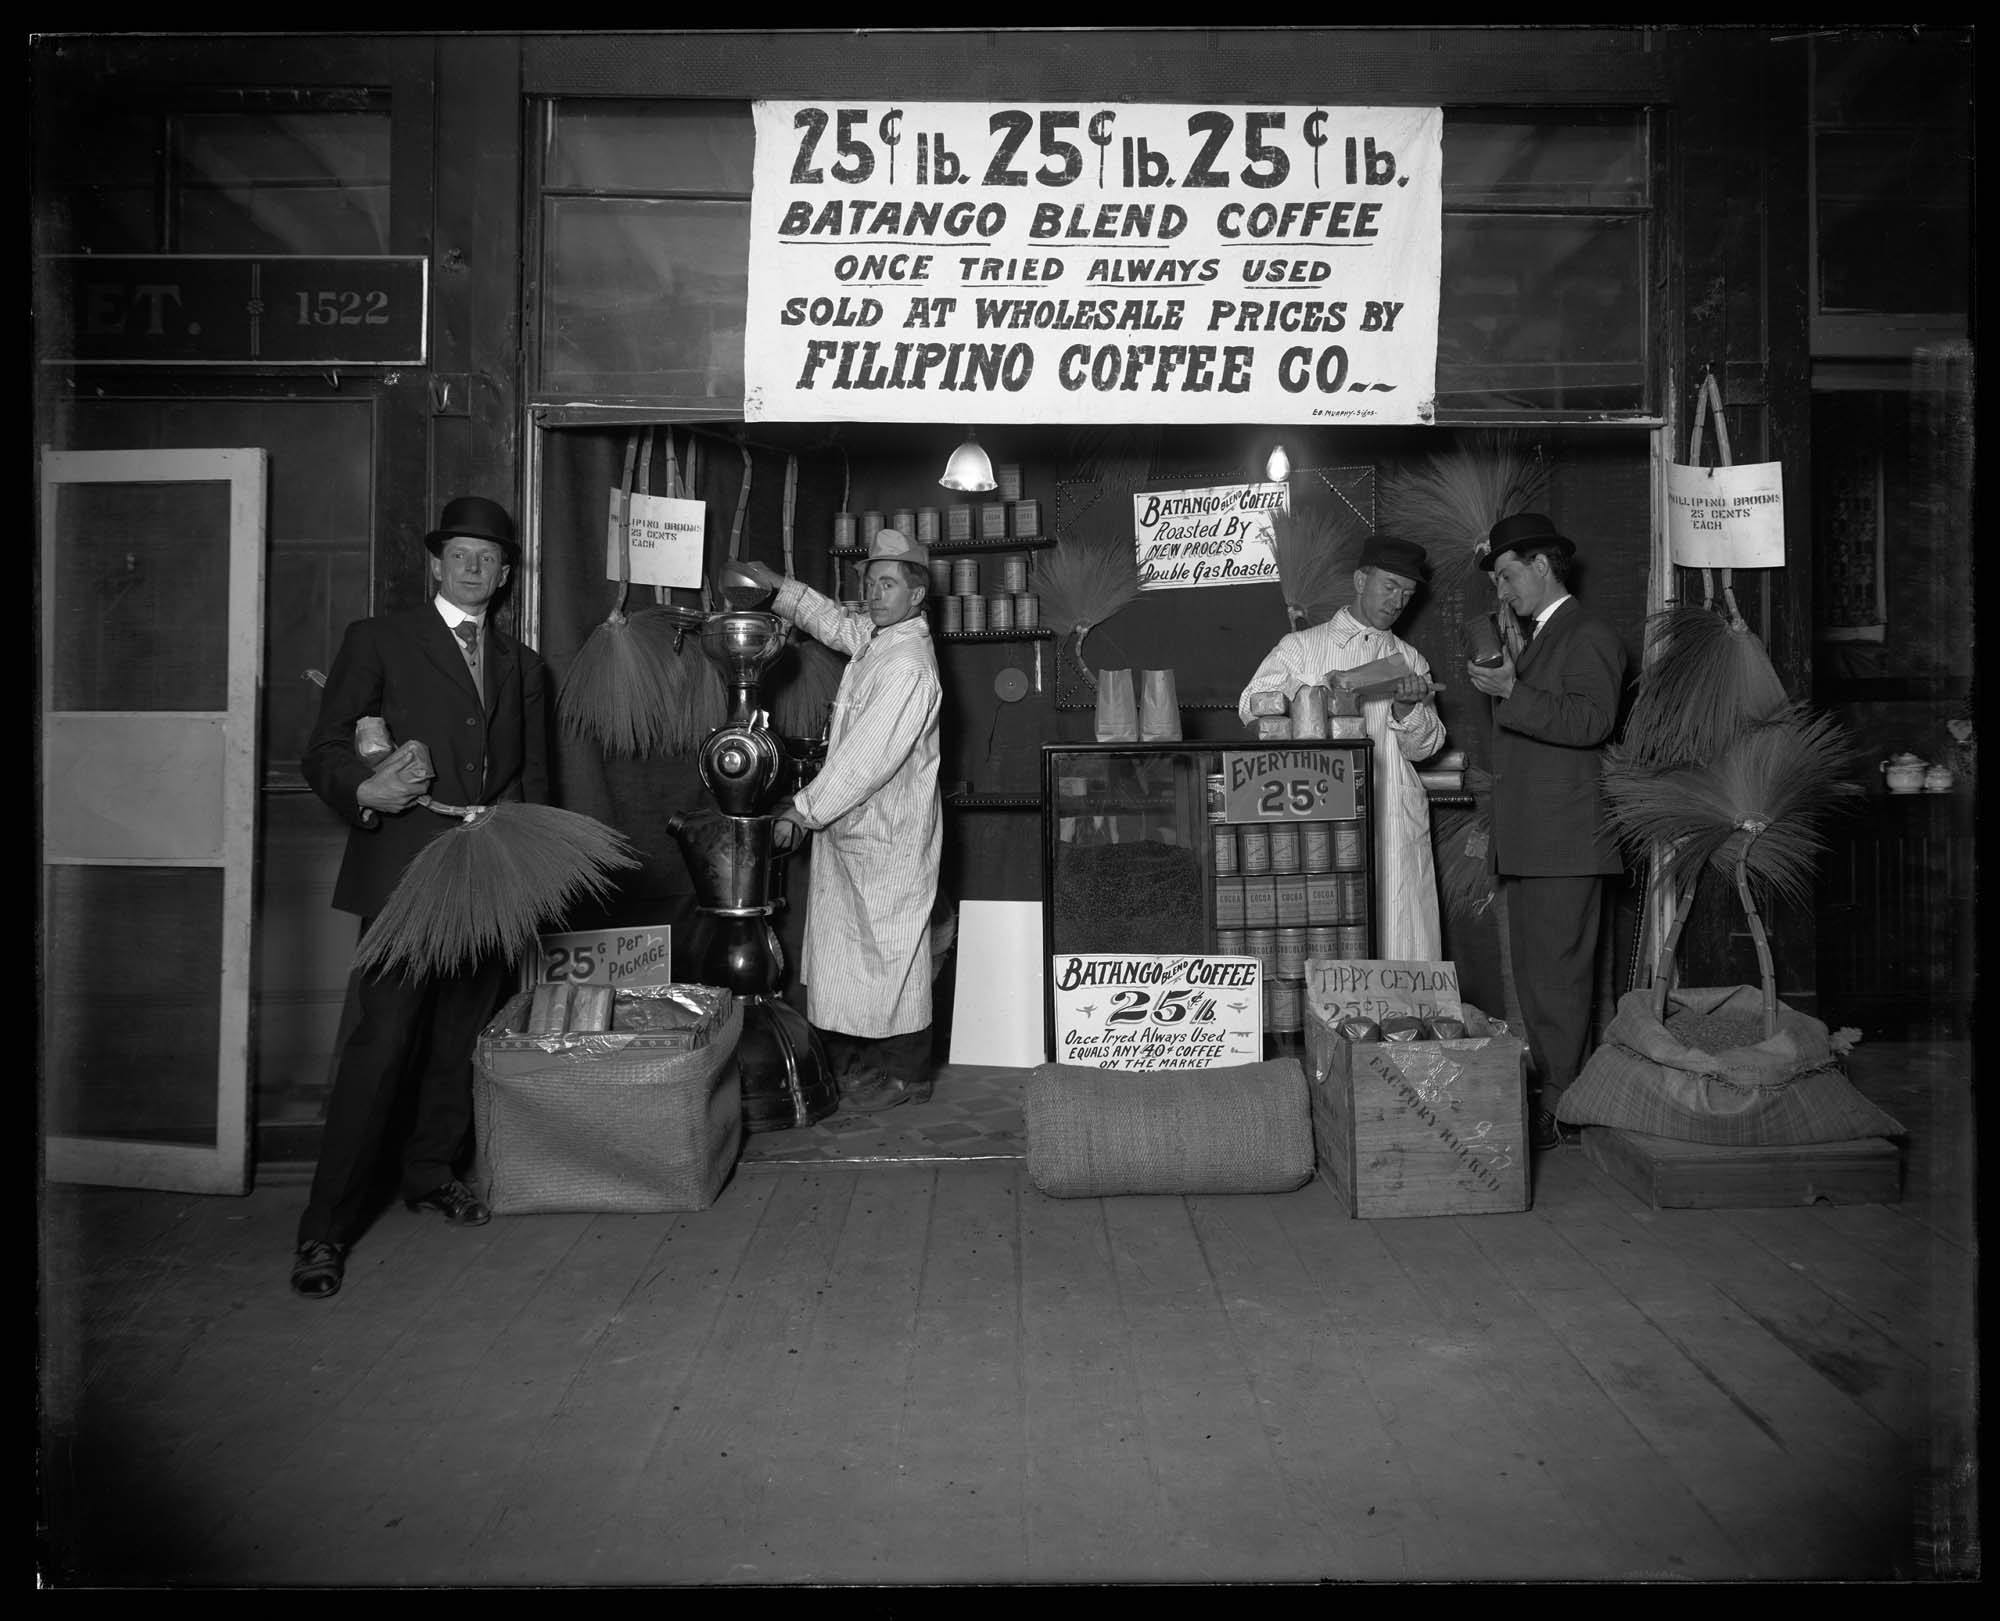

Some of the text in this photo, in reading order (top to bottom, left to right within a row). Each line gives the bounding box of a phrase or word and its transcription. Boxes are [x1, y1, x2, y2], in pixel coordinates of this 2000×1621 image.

[917, 132, 971, 185] lb.
[1123, 137, 1177, 188] lb.
[1346, 137, 1410, 188] lb.
[777, 200, 1382, 239] BATANGO BLEND COFFEE
[834, 254, 1331, 283] ONCE TRIED ALWAYS USED
[295, 291, 389, 326] 1522
[781, 297, 1404, 332] SOLD AT WHOLESALE PRICES BY
[796, 339, 1034, 392] FILIPINO
[1059, 343, 1254, 393] COFFEE
[1140, 489, 1285, 527] BATANGO BLEND COFFEE
[1733, 494, 1780, 506] BROOMS
[1690, 508, 1751, 519] 25 CENTS
[1692, 520, 1722, 530] EACH
[631, 528, 677, 541] 25 CENTS
[1152, 518, 1222, 541] Roasted
[631, 539, 655, 548] EACH
[1146, 539, 1244, 559] NEW PROCESS
[1145, 562, 1190, 581] Double
[1193, 561, 1220, 584] Gas
[1232, 751, 1344, 792] EVERYTHING
[617, 934, 645, 955] Per
[609, 944, 665, 981] PACKAGE
[1056, 957, 1257, 991] BATANGO BLEND COFFEE
[1315, 966, 1459, 993] TIPPY CEYLON
[1065, 1027, 1226, 1046] Once Tryed Always Used
[1068, 1046, 1110, 1060] EQUALS
[1112, 1045, 1141, 1058] ANY
[1176, 1045, 1225, 1057] COFFEE
[1100, 1059, 1213, 1069] ON THE MARKET
